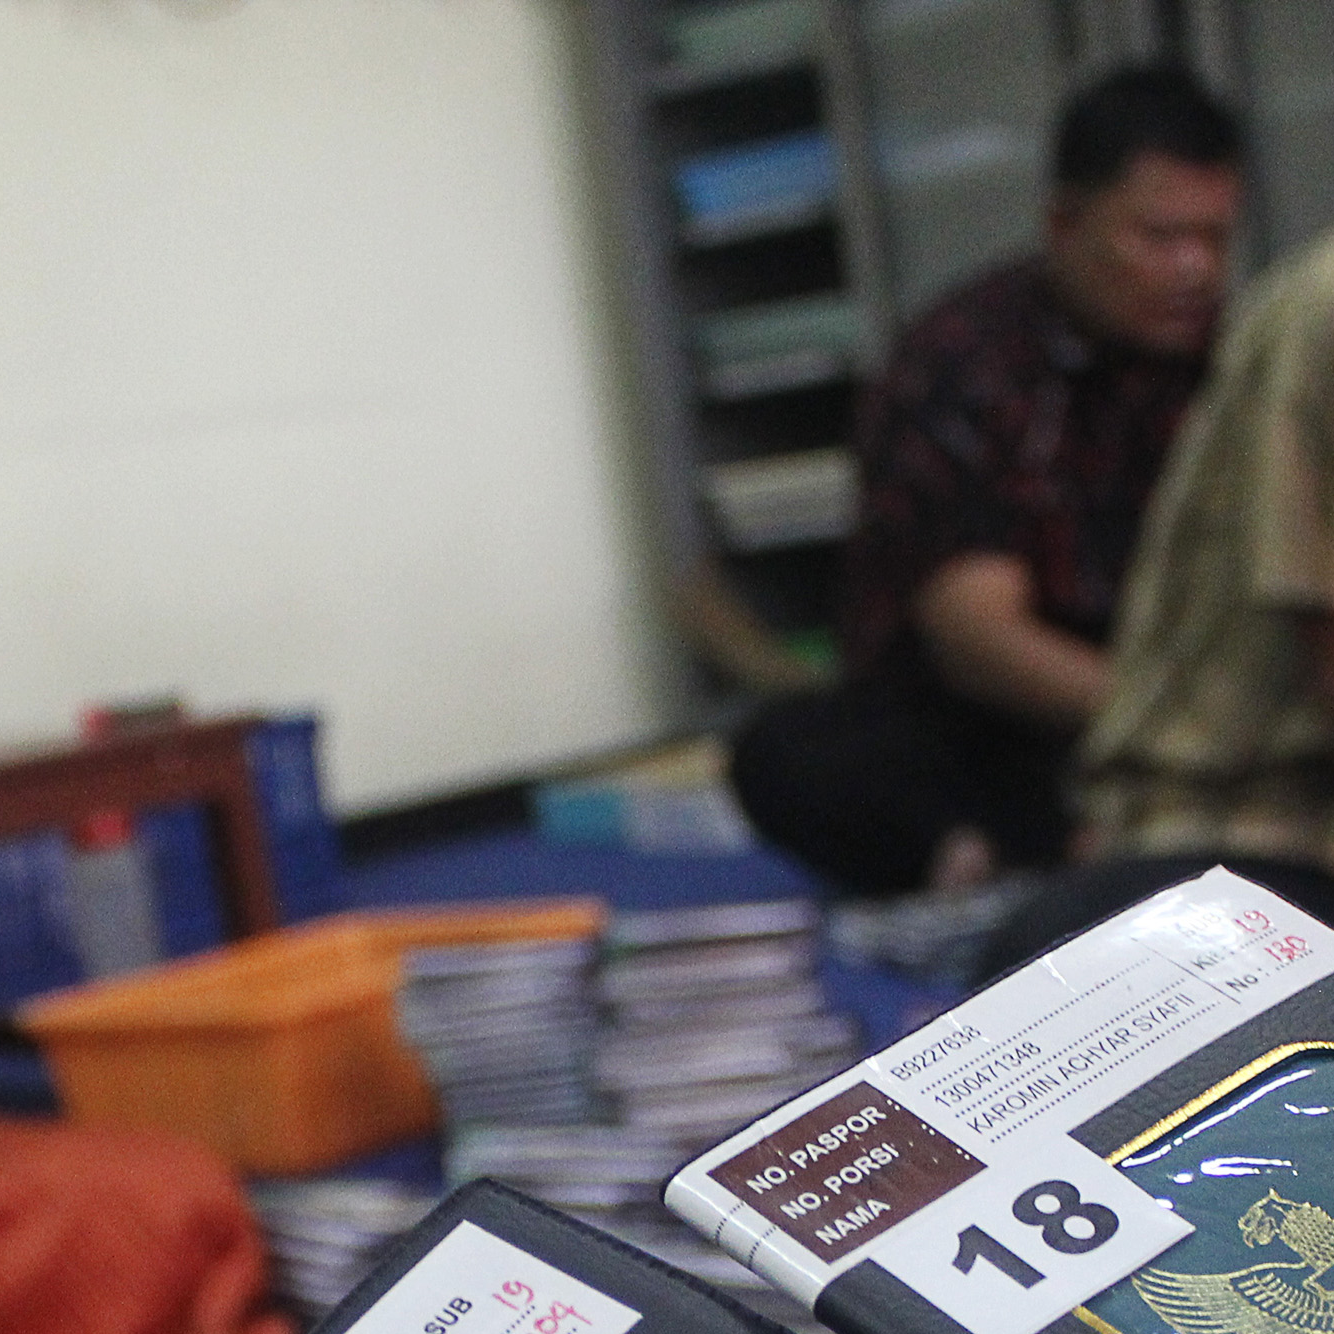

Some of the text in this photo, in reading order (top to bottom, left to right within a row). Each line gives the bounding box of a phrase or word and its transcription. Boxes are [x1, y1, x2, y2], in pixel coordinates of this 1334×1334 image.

[1234, 909, 1274, 934] 19
[1264, 934, 1308, 963] 130
[1225, 974, 1259, 993] No
[933, 1041, 1042, 1108] 1300471348
[966, 992, 1196, 1135] KAROMIN ACHYAR SYAFII
[745, 1105, 887, 1195] NO. PASPOR
[779, 1141, 900, 1220] NO. PORSI
[814, 1198, 892, 1246] NAMA
[950, 1179, 1121, 1290] 18
[491, 1280, 535, 1311] 19
